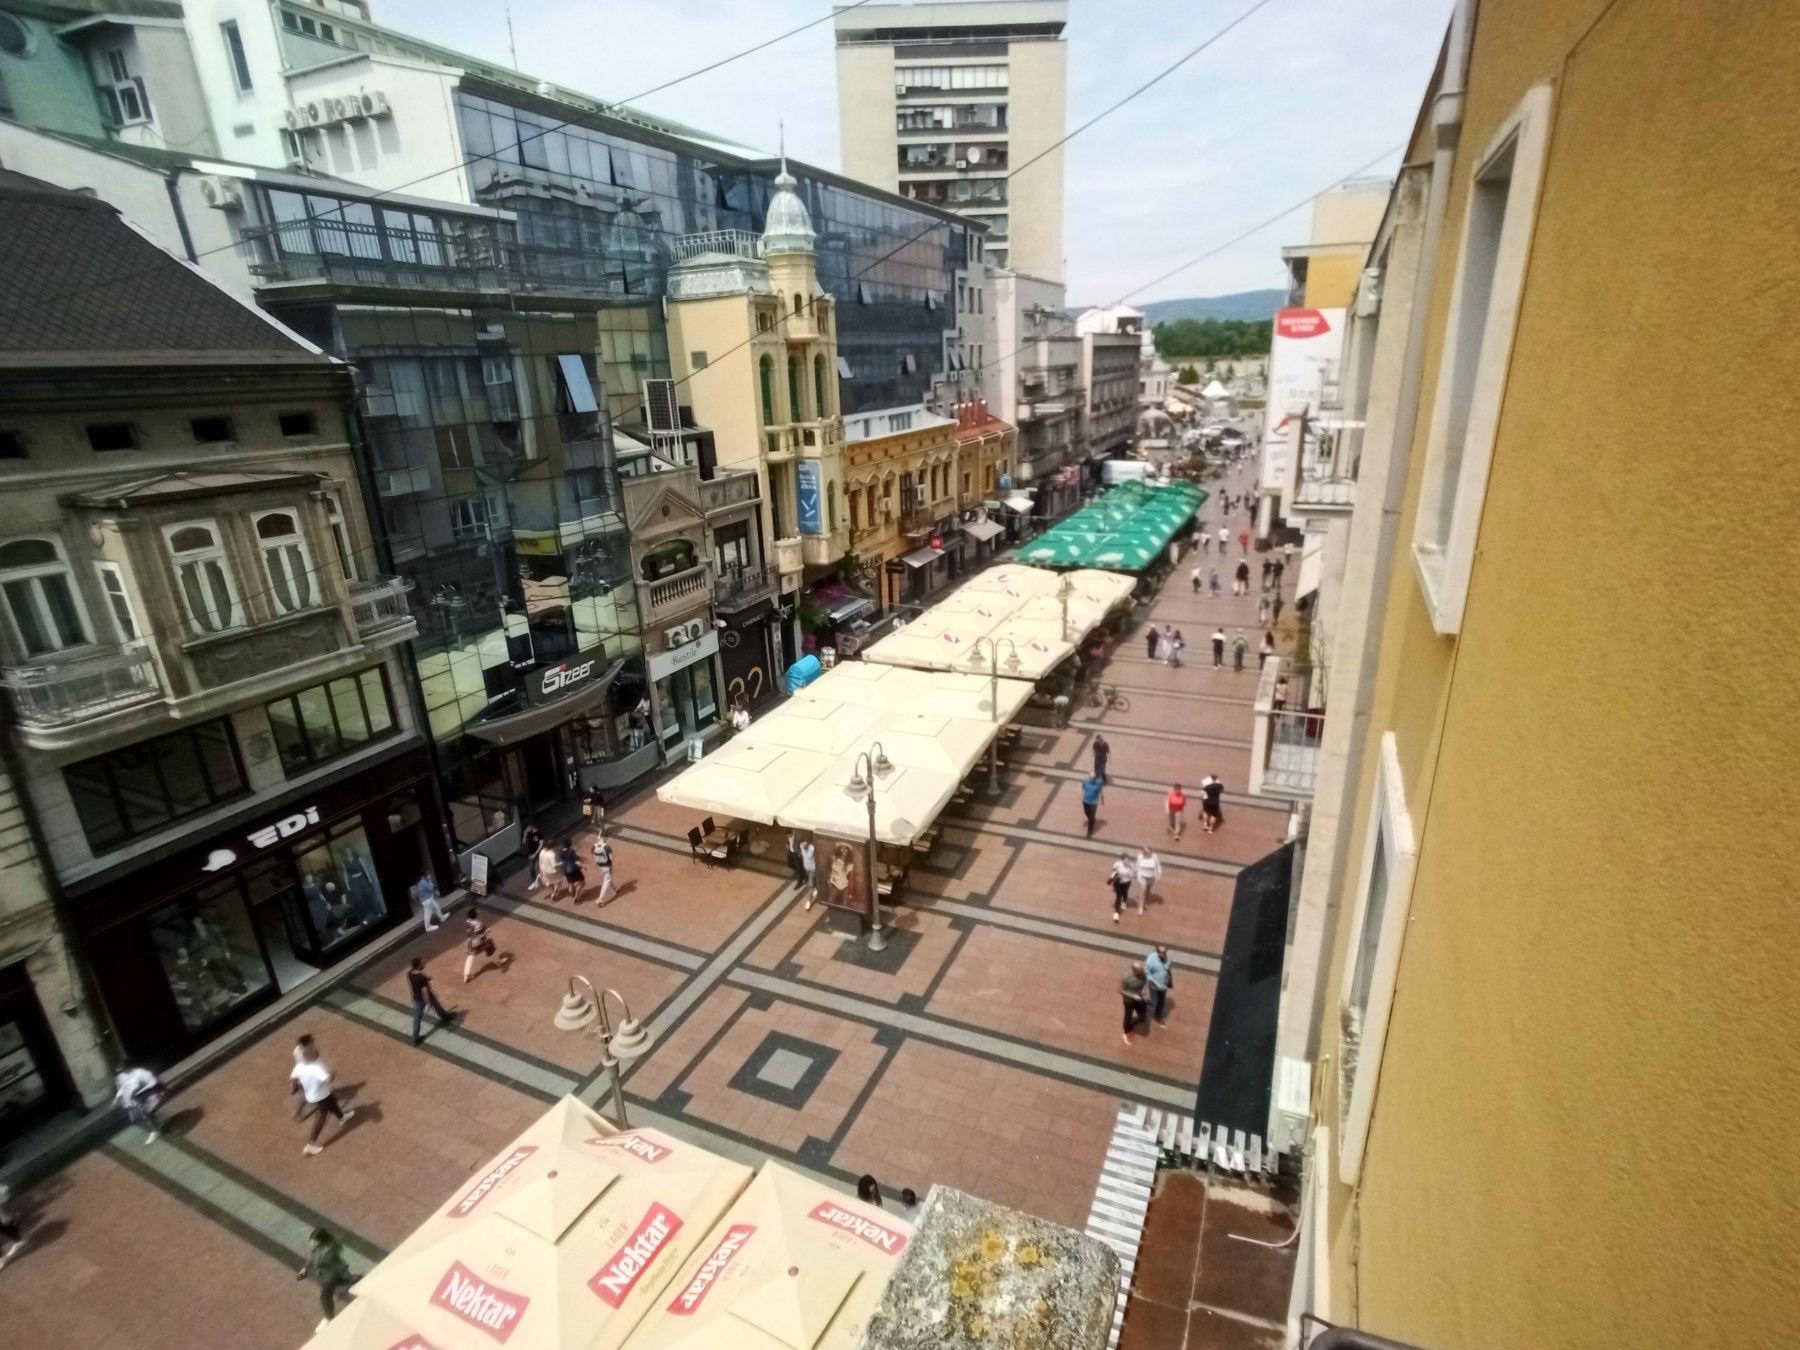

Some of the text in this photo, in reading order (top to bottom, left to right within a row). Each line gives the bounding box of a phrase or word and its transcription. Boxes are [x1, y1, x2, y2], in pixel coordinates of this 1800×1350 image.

[542, 660, 595, 694] Sizeer
[458, 1152, 529, 1213] Nektar
[598, 1213, 670, 1296] Nektar
[819, 1206, 898, 1250] Nektar
[441, 1271, 517, 1329] Nektar
[680, 1232, 749, 1309] Nektar
